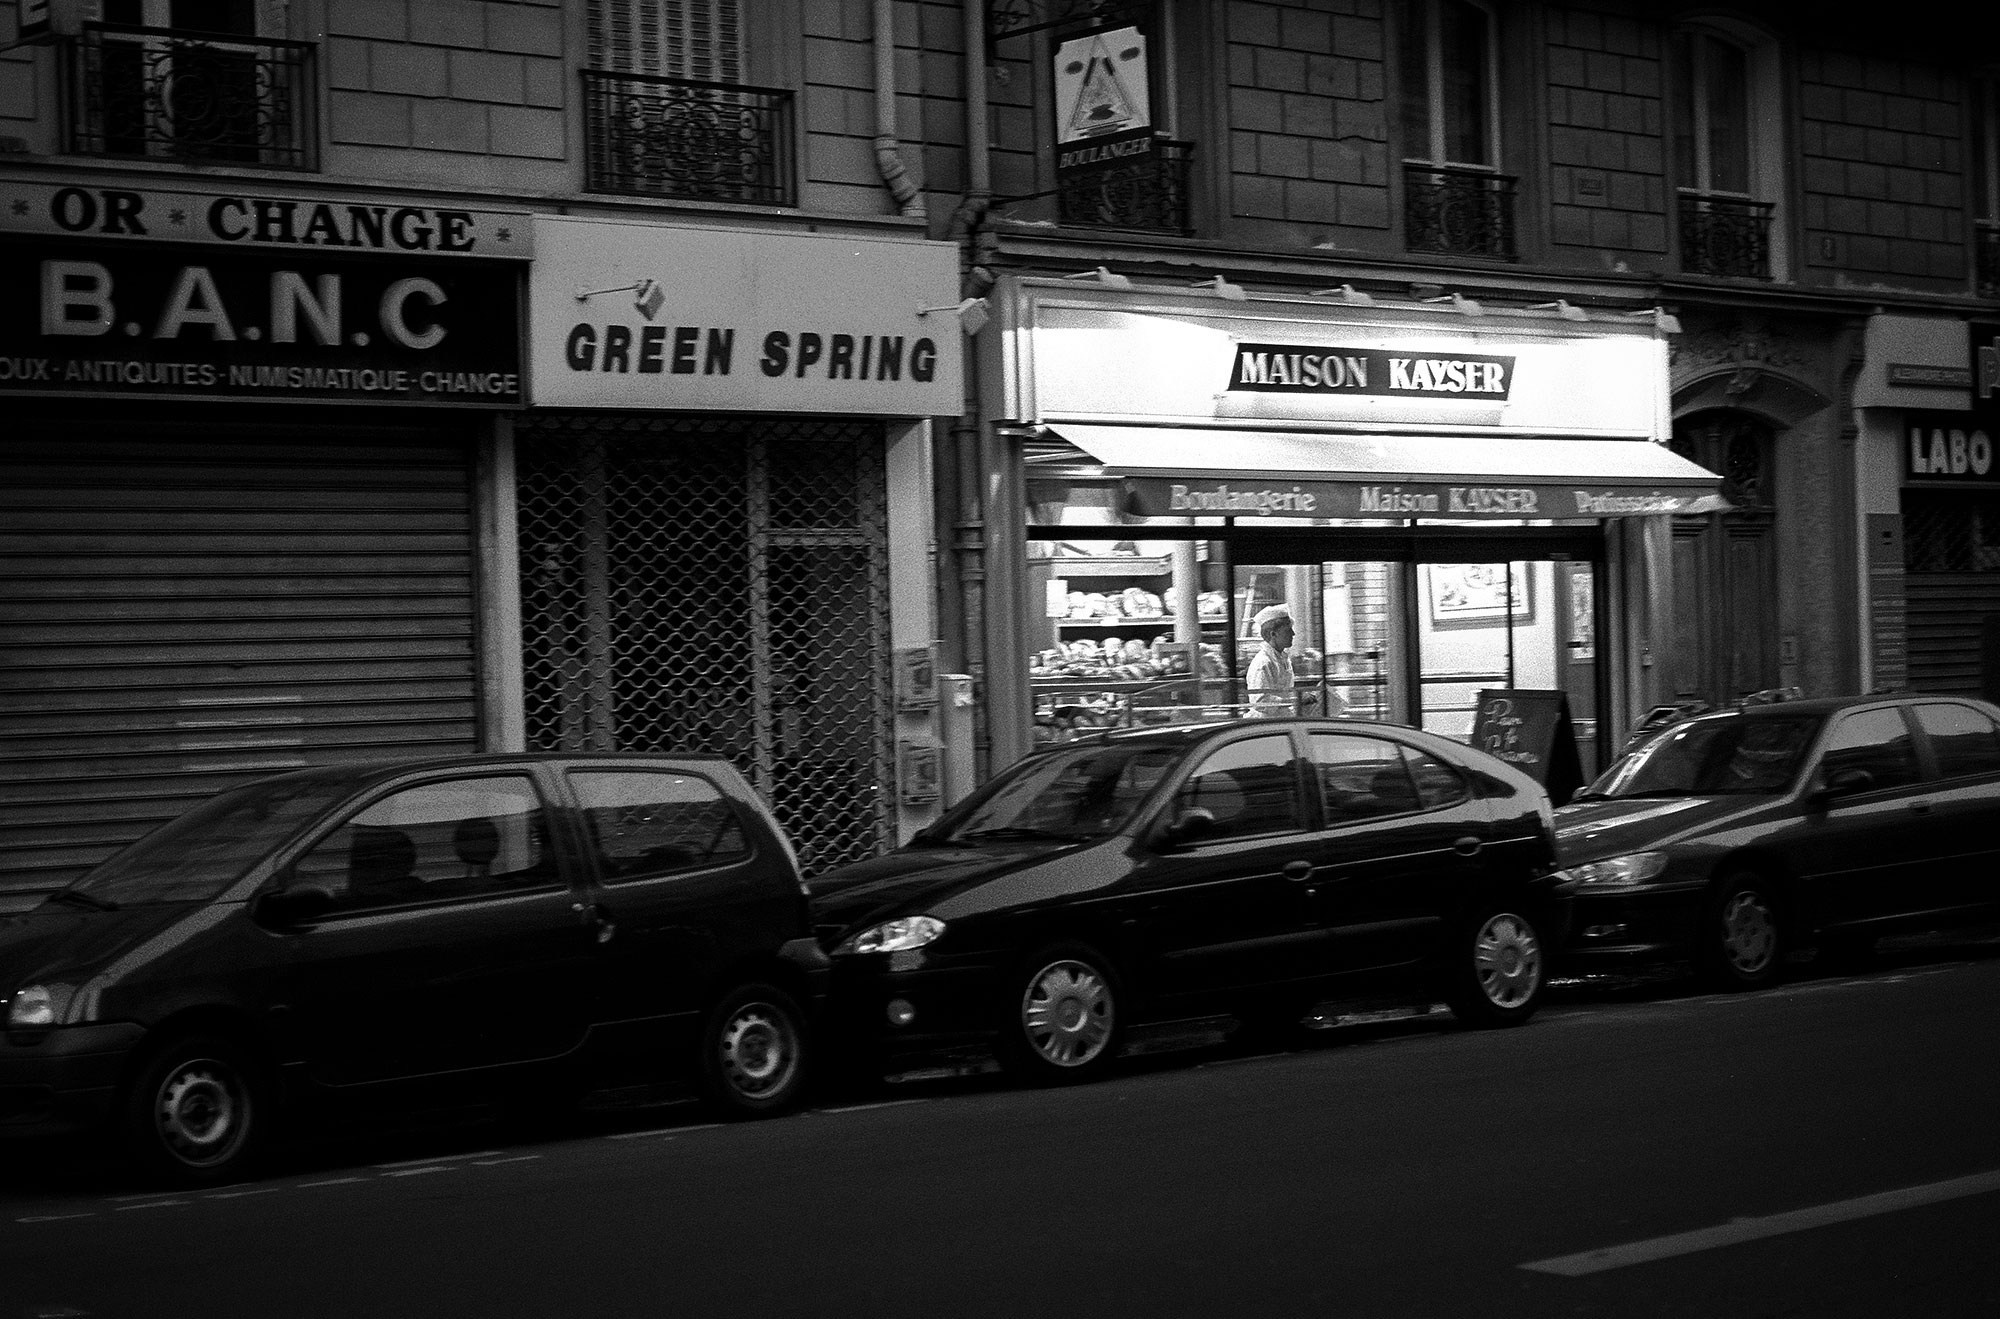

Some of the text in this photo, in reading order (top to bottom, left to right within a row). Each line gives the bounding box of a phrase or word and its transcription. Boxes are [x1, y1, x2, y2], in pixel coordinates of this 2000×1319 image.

[51, 188, 476, 252] OR CHANGE
[40, 259, 449, 350] B.A.N.C
[64, 360, 217, 386] ANTIQUITES
[229, 365, 409, 391] NUMISMATIQUE
[419, 371, 518, 394] CHANGE
[567, 323, 936, 383] GREEN SPRING
[1240, 351, 1505, 393] MAISON KAYSER
[1910, 427, 1993, 475] LABO
[1169, 484, 1318, 515] Boulangerie
[1360, 486, 1439, 512] Maison
[1449, 488, 1539, 513] KAYSER
